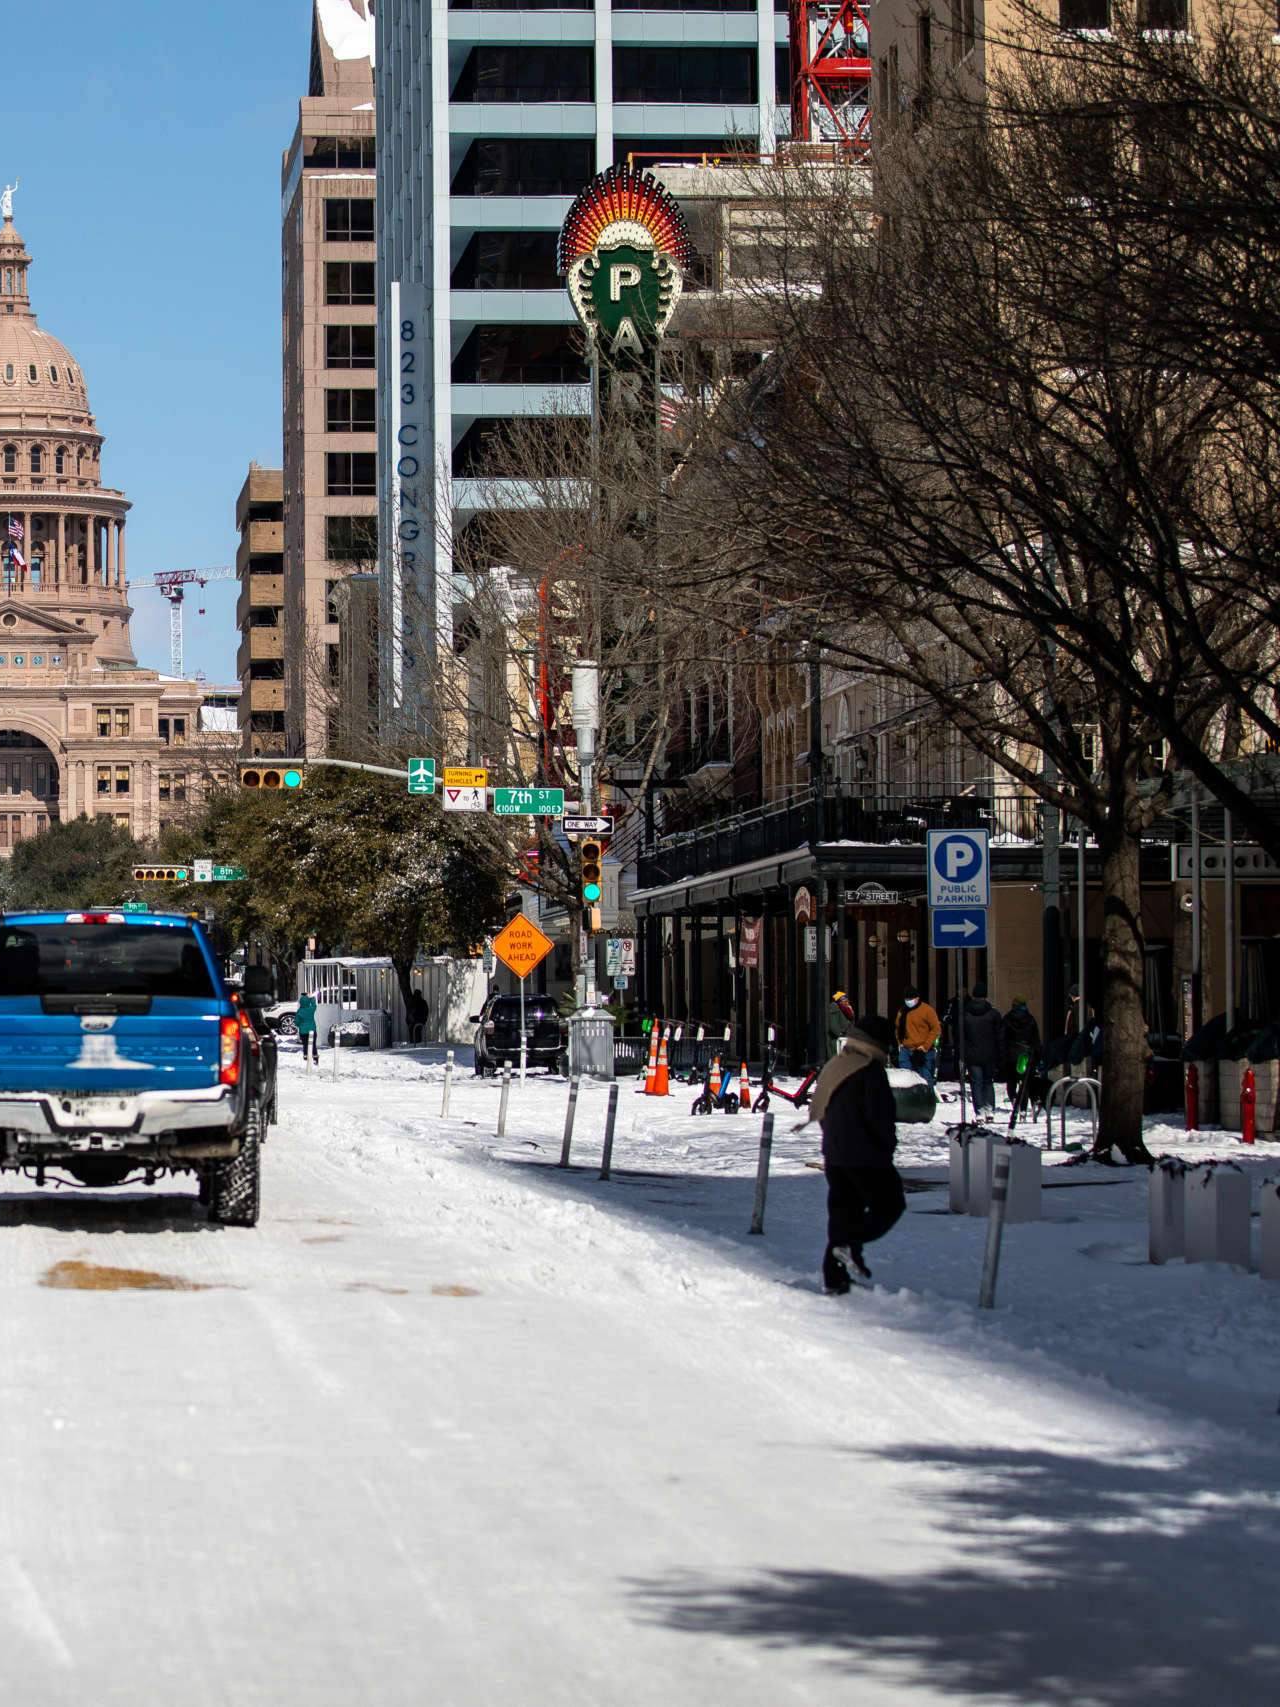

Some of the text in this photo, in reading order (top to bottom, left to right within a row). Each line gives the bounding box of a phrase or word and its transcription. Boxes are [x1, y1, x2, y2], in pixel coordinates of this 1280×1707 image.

[398, 424, 420, 669] CONGRSS
[508, 790, 551, 804] 7th ST
[567, 820, 598, 829] ONE WAY
[946, 842, 974, 878] P
[940, 884, 977, 893] PUBLIC
[866, 892, 895, 900] STREET
[936, 894, 982, 903] PARKING
[509, 930, 533, 938] ROAD
[510, 942, 533, 950] WORK
[507, 953, 537, 961] AHEAD
